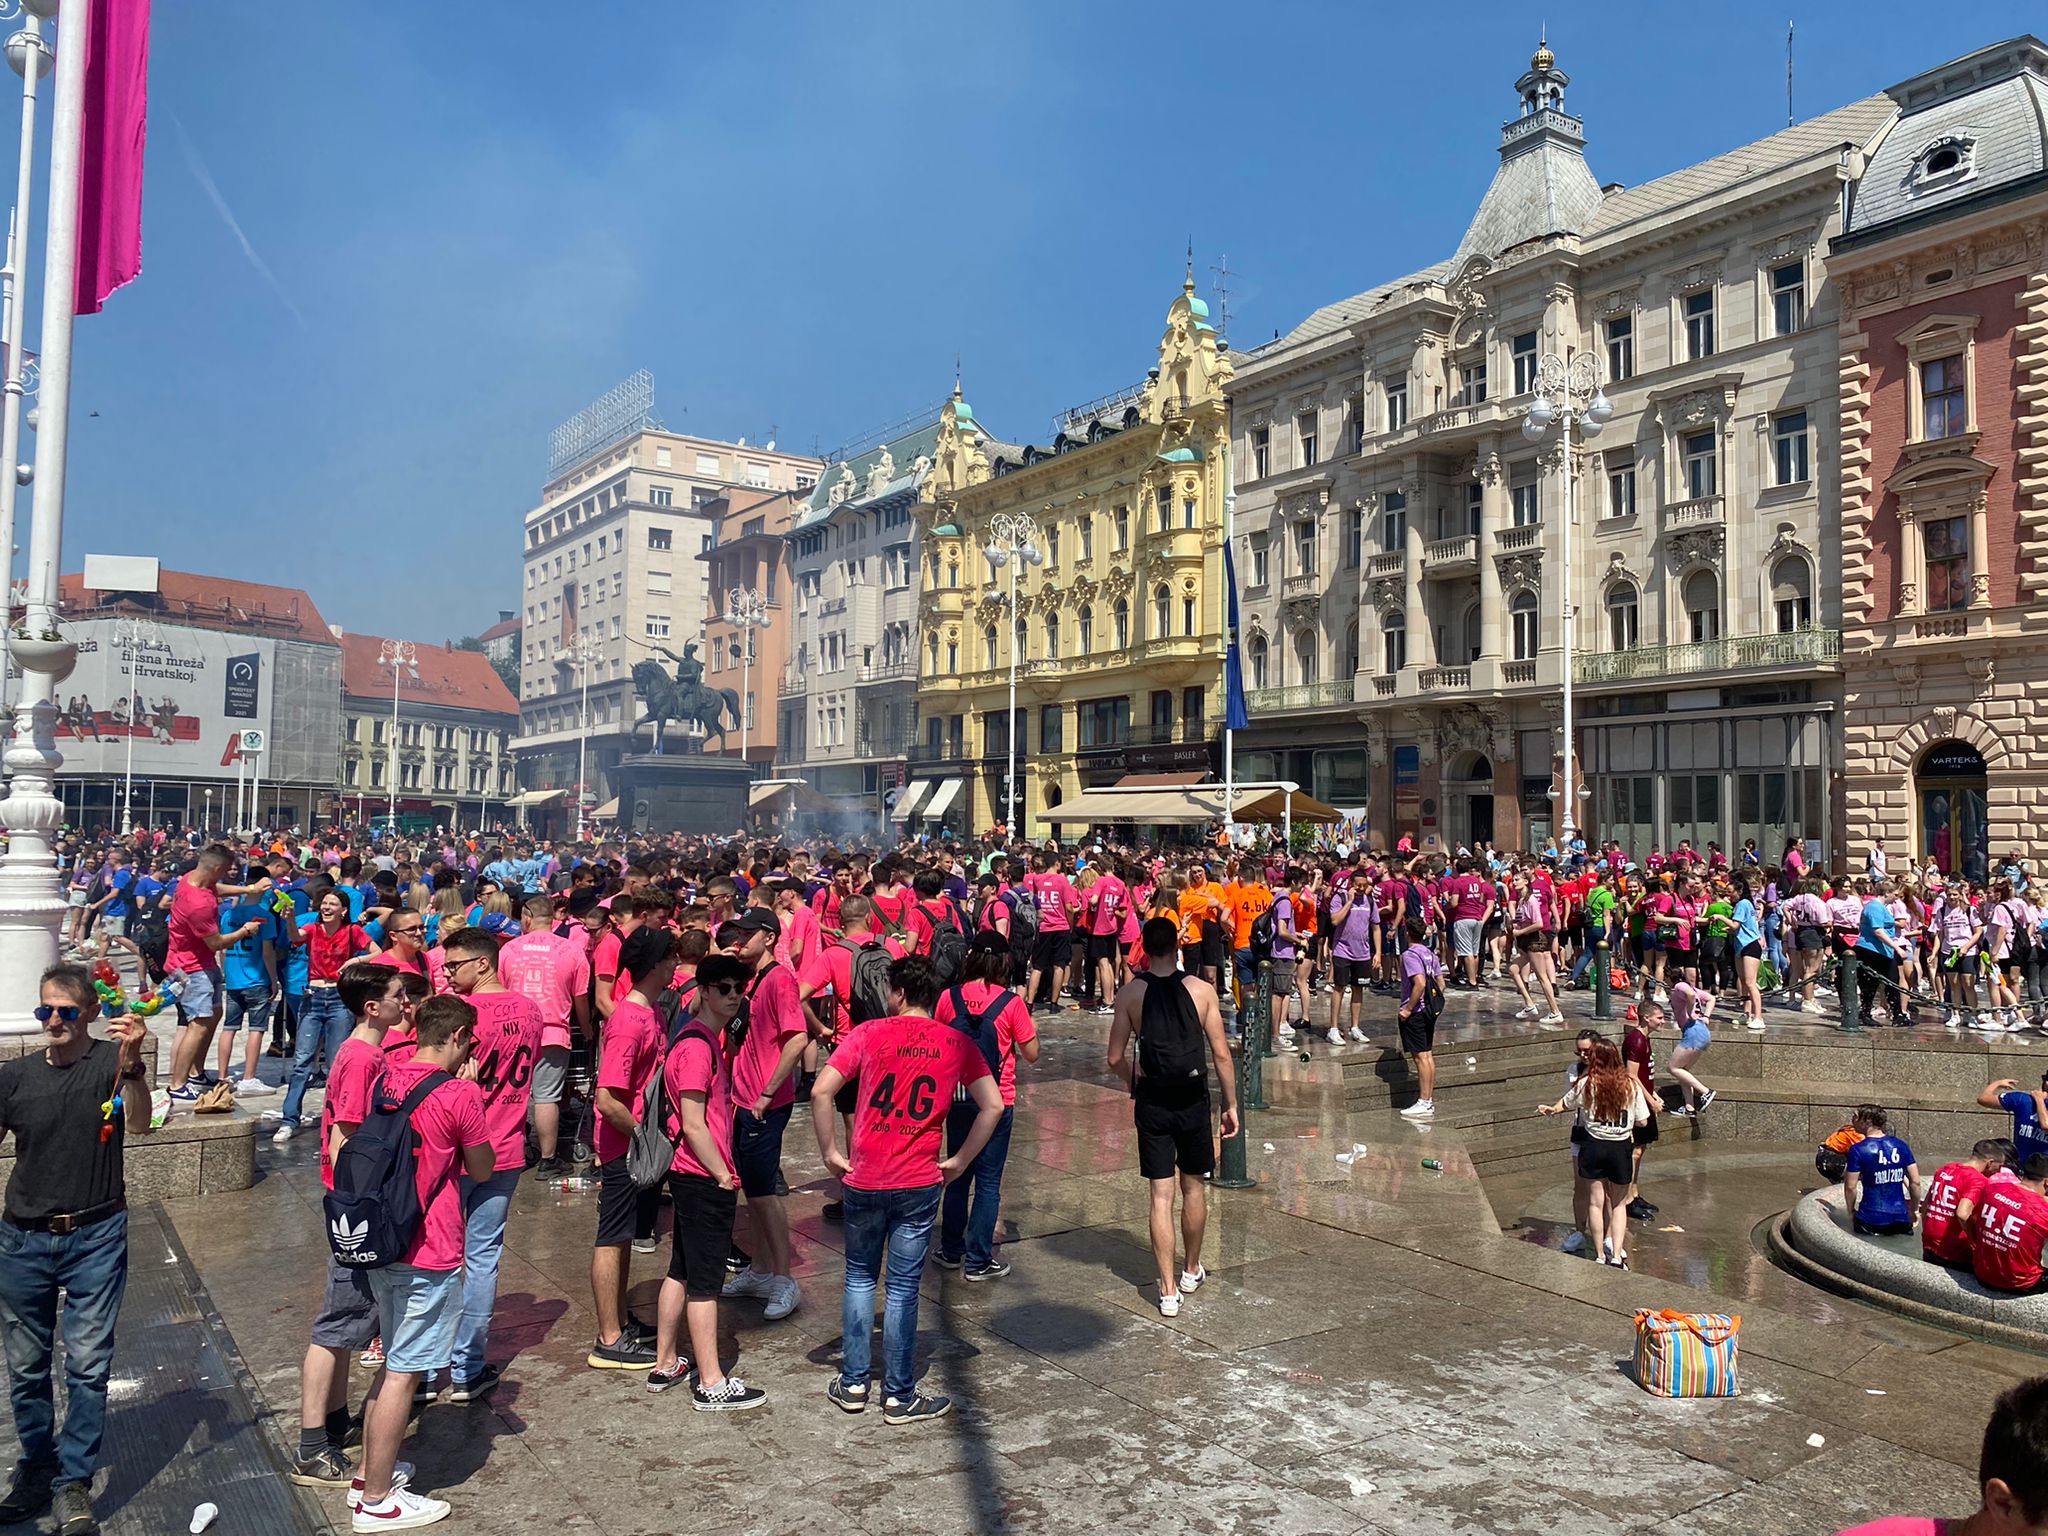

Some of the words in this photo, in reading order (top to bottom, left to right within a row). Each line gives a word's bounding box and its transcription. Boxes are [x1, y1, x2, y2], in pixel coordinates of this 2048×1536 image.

[78, 638, 98, 653] eža
[121, 650, 162, 665] fiksna
[166, 656, 205, 670] mreža
[121, 665, 129, 675] u
[135, 664, 197, 683] Hrvatskoj.
[1174, 751, 1197, 760] BASLER
[1931, 756, 1978, 765] VARTEKS
[1037, 890, 1060, 904] 4.E
[502, 1021, 520, 1037] NIX
[895, 1045, 941, 1060] VINOPIJA
[477, 1045, 532, 1092] 4.G
[501, 1094, 524, 1105] 2022
[869, 1072, 937, 1121] 4.G
[1980, 1203, 2027, 1242] 4.E
[334, 1251, 379, 1263] adidas
